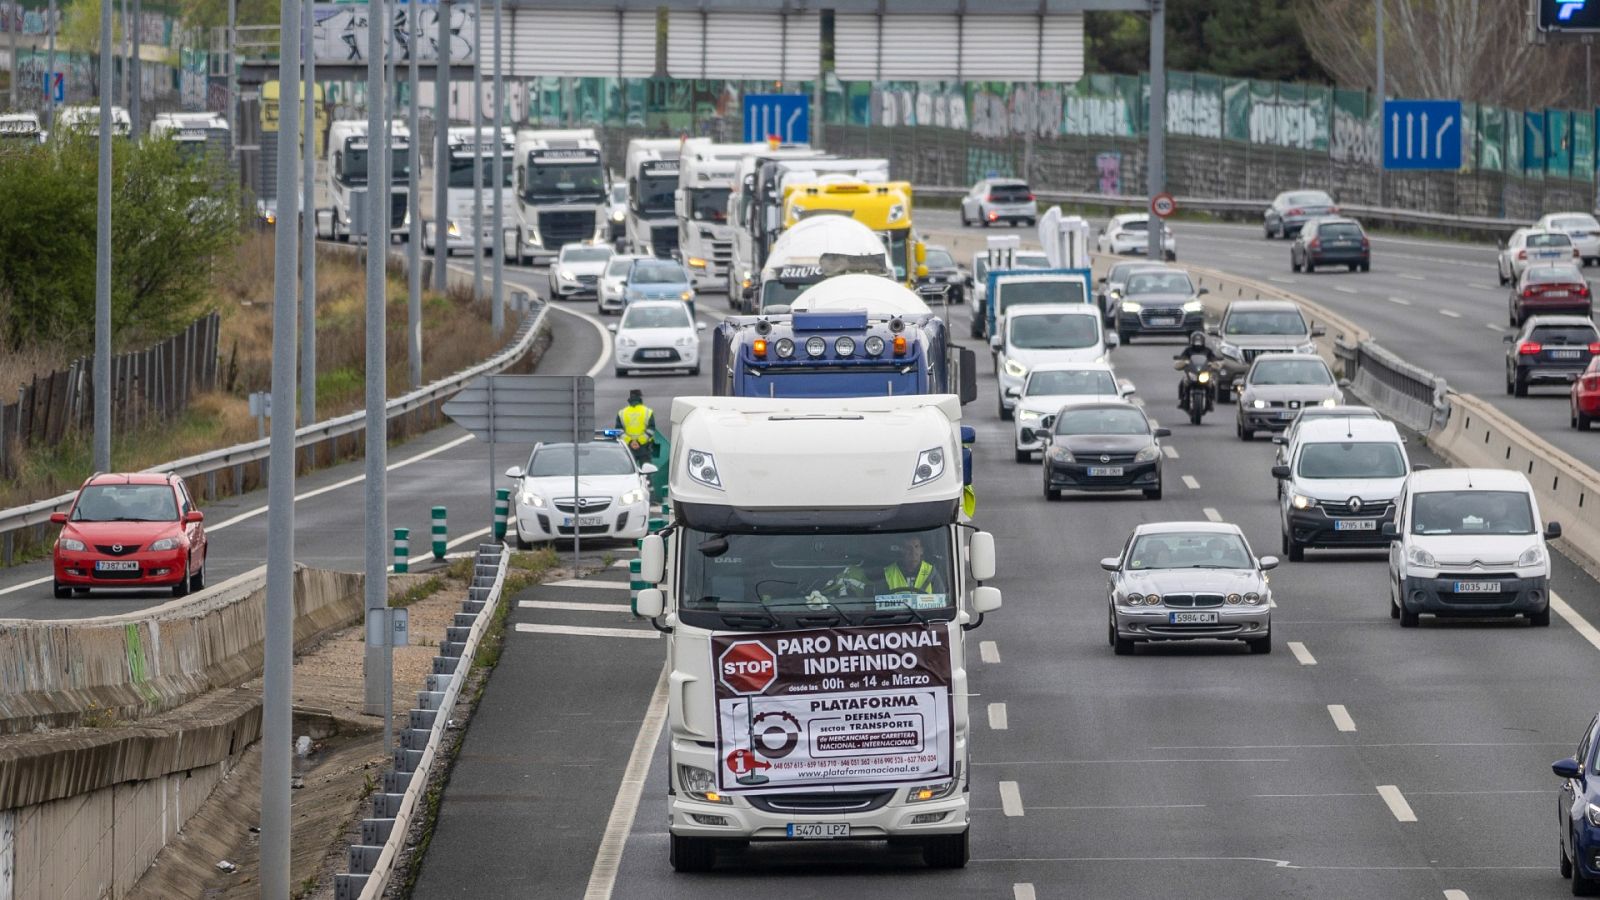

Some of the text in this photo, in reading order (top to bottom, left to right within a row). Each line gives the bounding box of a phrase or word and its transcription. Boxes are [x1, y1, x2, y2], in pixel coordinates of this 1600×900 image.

[101, 562, 120, 570] 7387
[1460, 583, 1498, 591] 8035 JJT
[1178, 614, 1196, 622] 5984
[777, 630, 942, 656] PARO NACIONAL
[724, 660, 772, 674] STOP
[804, 652, 918, 675] INDEFINIDO
[822, 677, 844, 690] 00h
[862, 676, 877, 687] 14
[892, 674, 930, 686] Marzo
[810, 696, 918, 712] PLATAFORMA
[845, 712, 891, 722] DEFENSA
[850, 720, 914, 731] TRANSPORTE
[881, 732, 916, 740] CARRETERA
[862, 739, 916, 748] INTERNACIONAL
[798, 764, 920, 778] www.plataformanacional.es
[796, 824, 846, 836] 5470 LPZ
